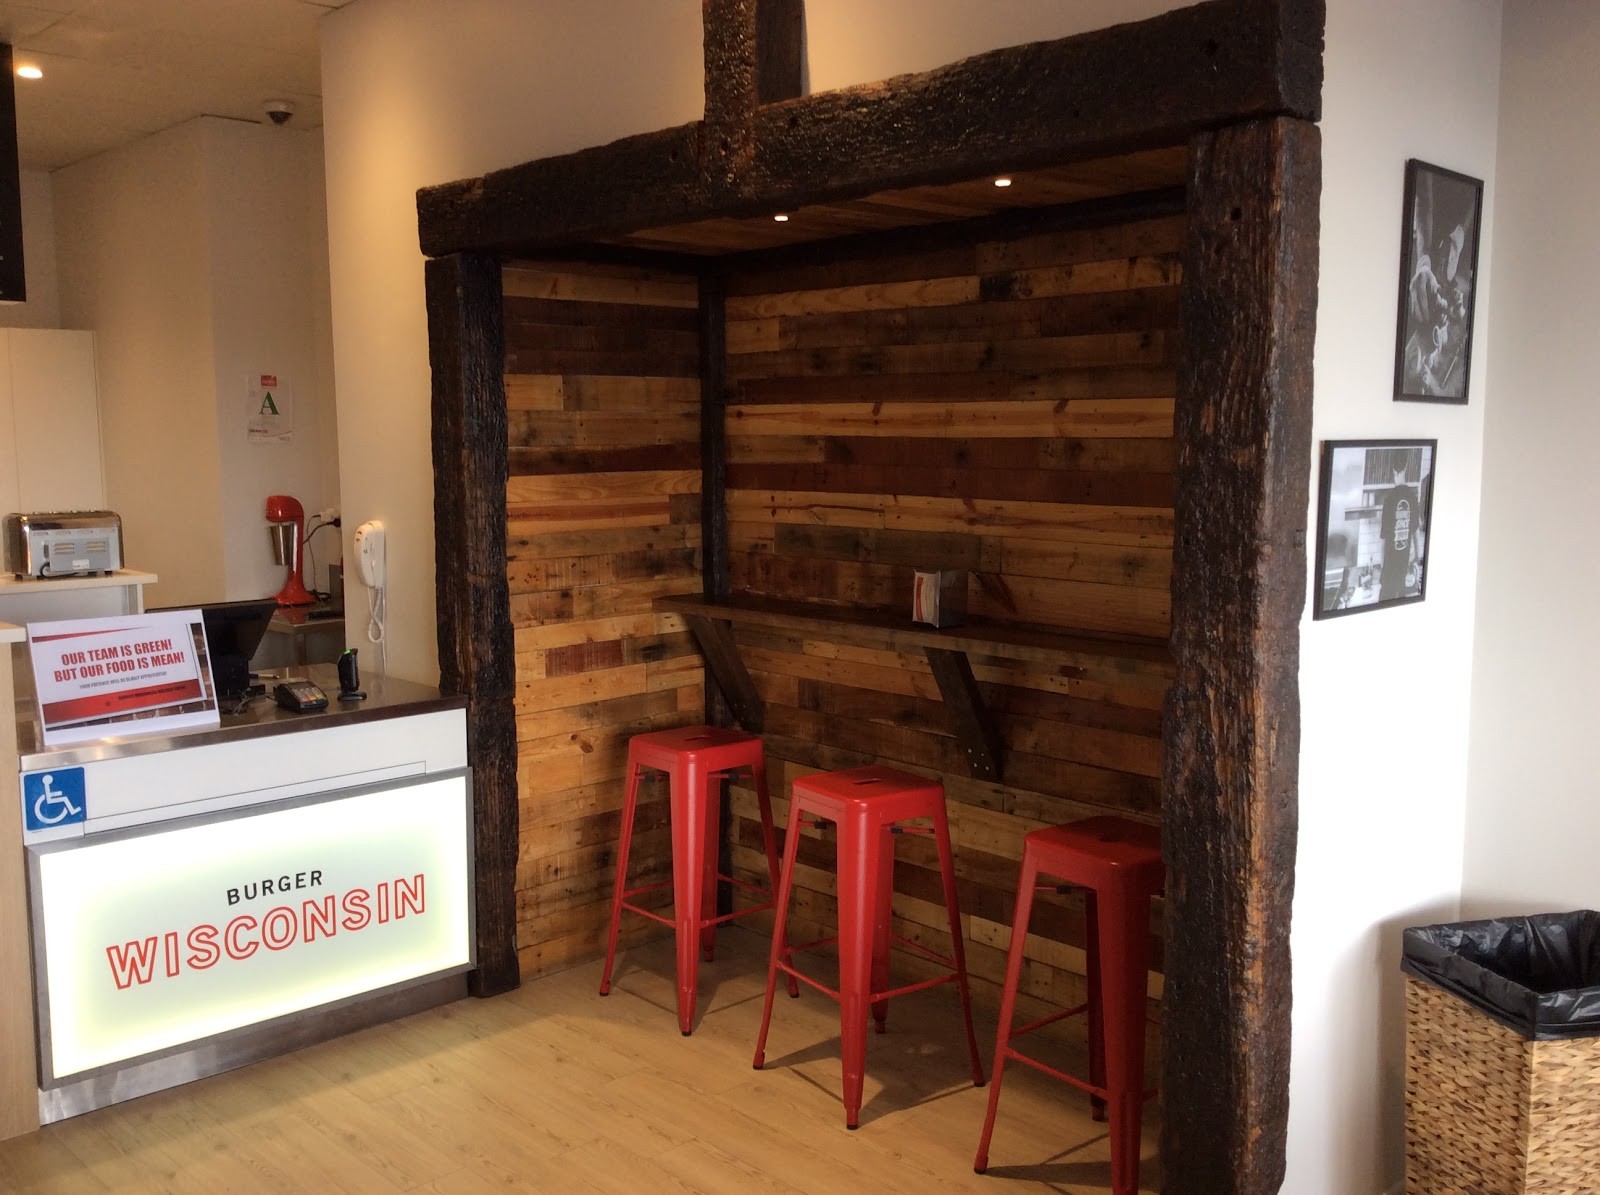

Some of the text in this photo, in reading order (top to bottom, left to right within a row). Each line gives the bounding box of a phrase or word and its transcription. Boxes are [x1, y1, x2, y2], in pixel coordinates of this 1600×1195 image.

[259, 391, 280, 415] A
[54, 651, 185, 682] BUT OUR FOOD IS MEAN!
[61, 638, 172, 666] OUR TEAM IS GREEN!
[226, 870, 323, 906] BURGER
[106, 874, 425, 990] WISCONSIN
